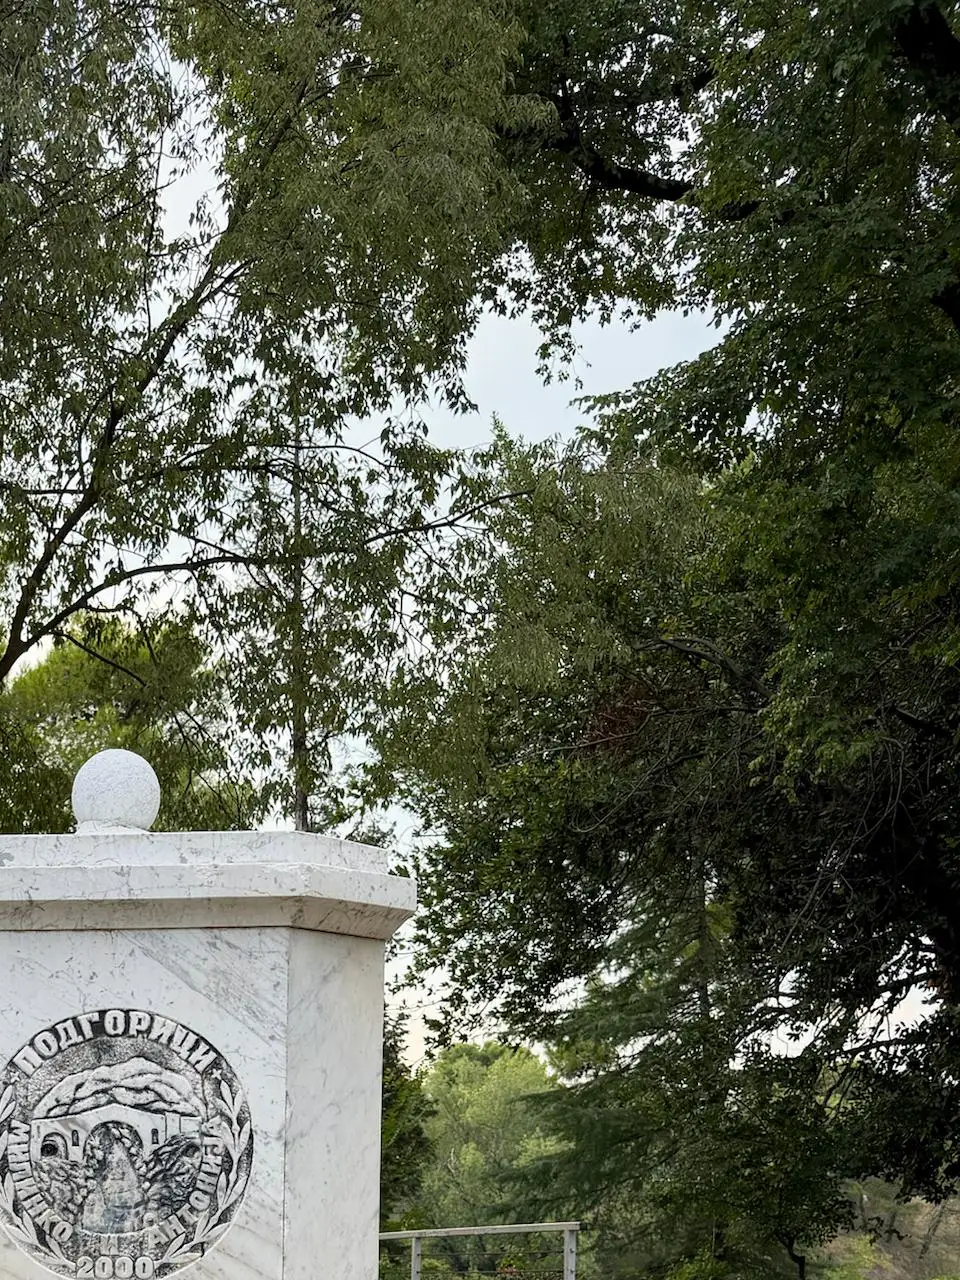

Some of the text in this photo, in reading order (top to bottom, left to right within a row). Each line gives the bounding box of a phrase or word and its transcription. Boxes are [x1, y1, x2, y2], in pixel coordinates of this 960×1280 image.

[13, 1009, 218, 1077] ПОДГОРИЦИ
[7, 1119, 74, 1243] МИЛИНКО
[76, 1255, 155, 1280] 2000
